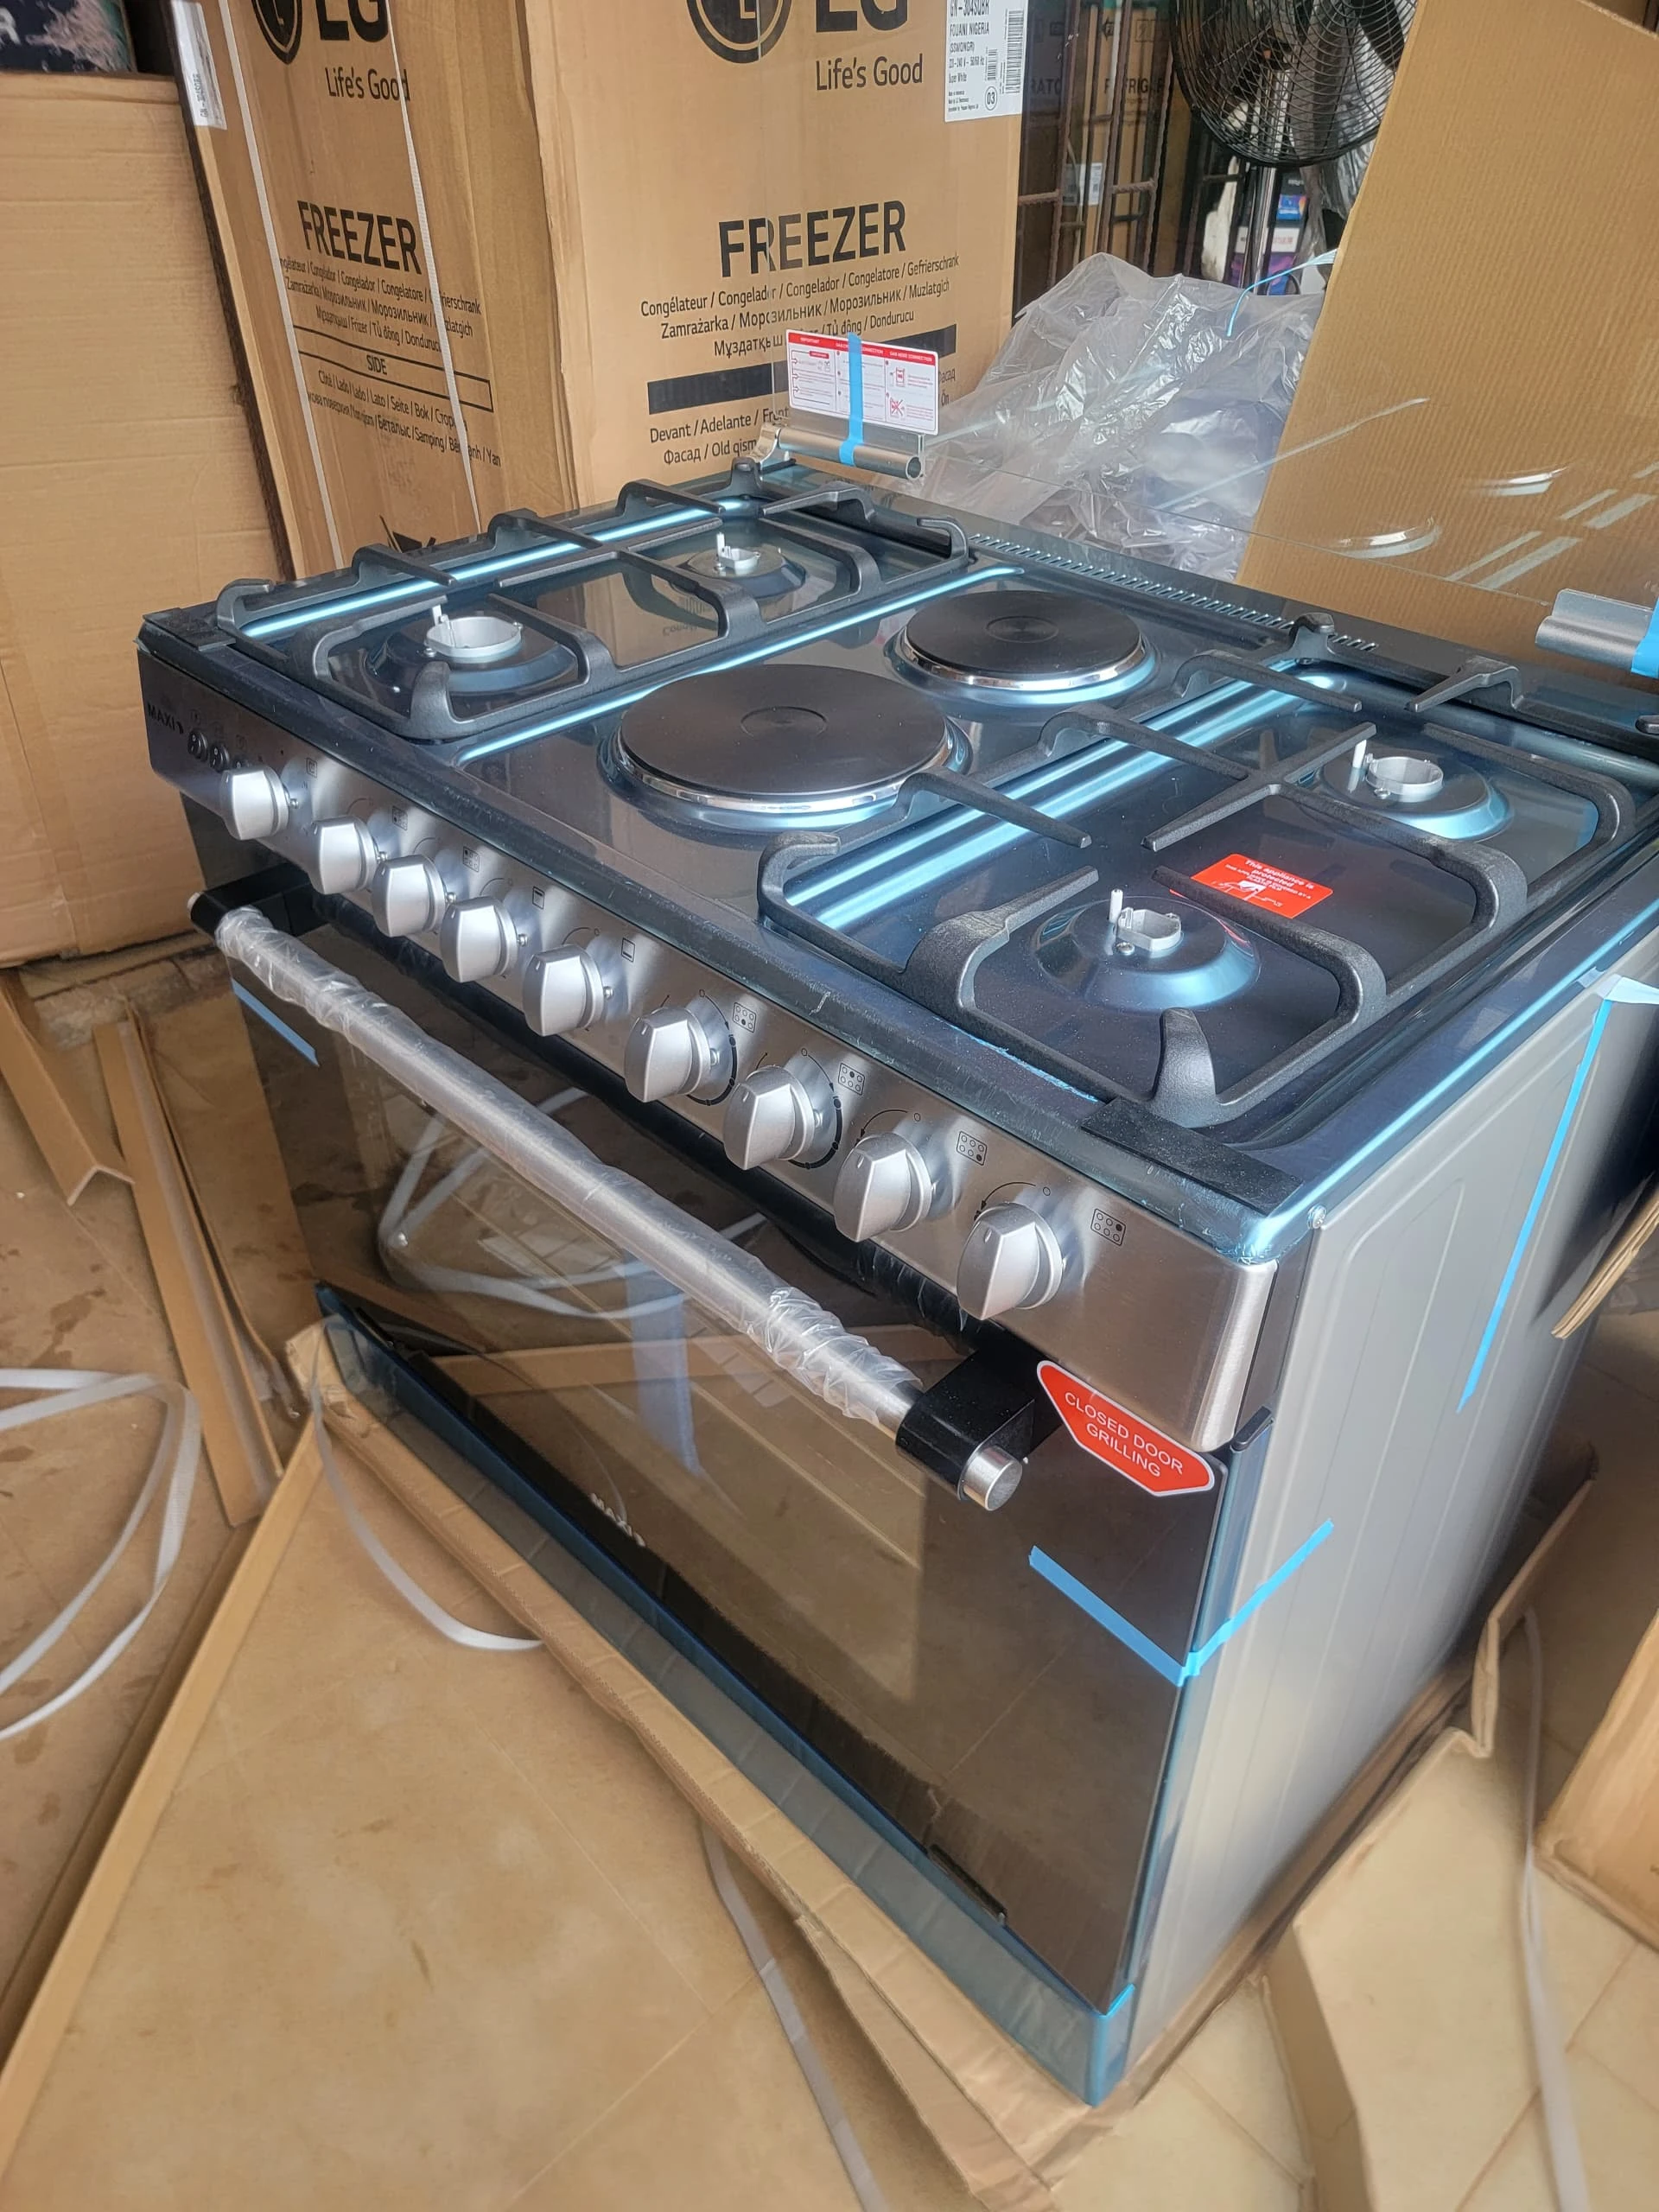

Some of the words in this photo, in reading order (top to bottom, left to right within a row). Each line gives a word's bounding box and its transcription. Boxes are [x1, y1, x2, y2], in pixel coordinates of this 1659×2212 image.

[969, 22, 989, 35] NIGERIA
[325, 67, 365, 99] Life's
[367, 68, 410, 101] Good
[874, 53, 923, 86] Good
[987, 92, 995, 105] 03
[297, 200, 422, 275] FREEZER
[719, 200, 906, 277] FREEZER
[340, 270, 375, 292] Congelador
[381, 279, 423, 302] Congelatore
[641, 296, 708, 318] Congélateur
[786, 276, 840, 299] Congelador
[849, 268, 899, 288] Congelatore
[907, 254, 959, 276] Gefrierschrank
[372, 299, 429, 327] Морозильник
[661, 315, 728, 339] Zamrażarka
[830, 290, 901, 315] Морозильник
[909, 276, 950, 299] Muzlatgich
[870, 310, 914, 329] Dondurucu
[366, 354, 387, 375] SIDE
[391, 396, 410, 414] Seite
[415, 402, 429, 421] Bok
[650, 423, 691, 443] Devant
[701, 414, 752, 435] Adelante
[416, 427, 444, 452] Samping
[486, 448, 501, 467] Yan
[664, 447, 701, 465] Фасад
[712, 440, 730, 457] Old
[733, 438, 757, 458] qism
[1065, 1392, 1129, 1439] CLOSED
[1134, 1433, 1183, 1475] DOOR
[1086, 1423, 1161, 1478] GRILLING
